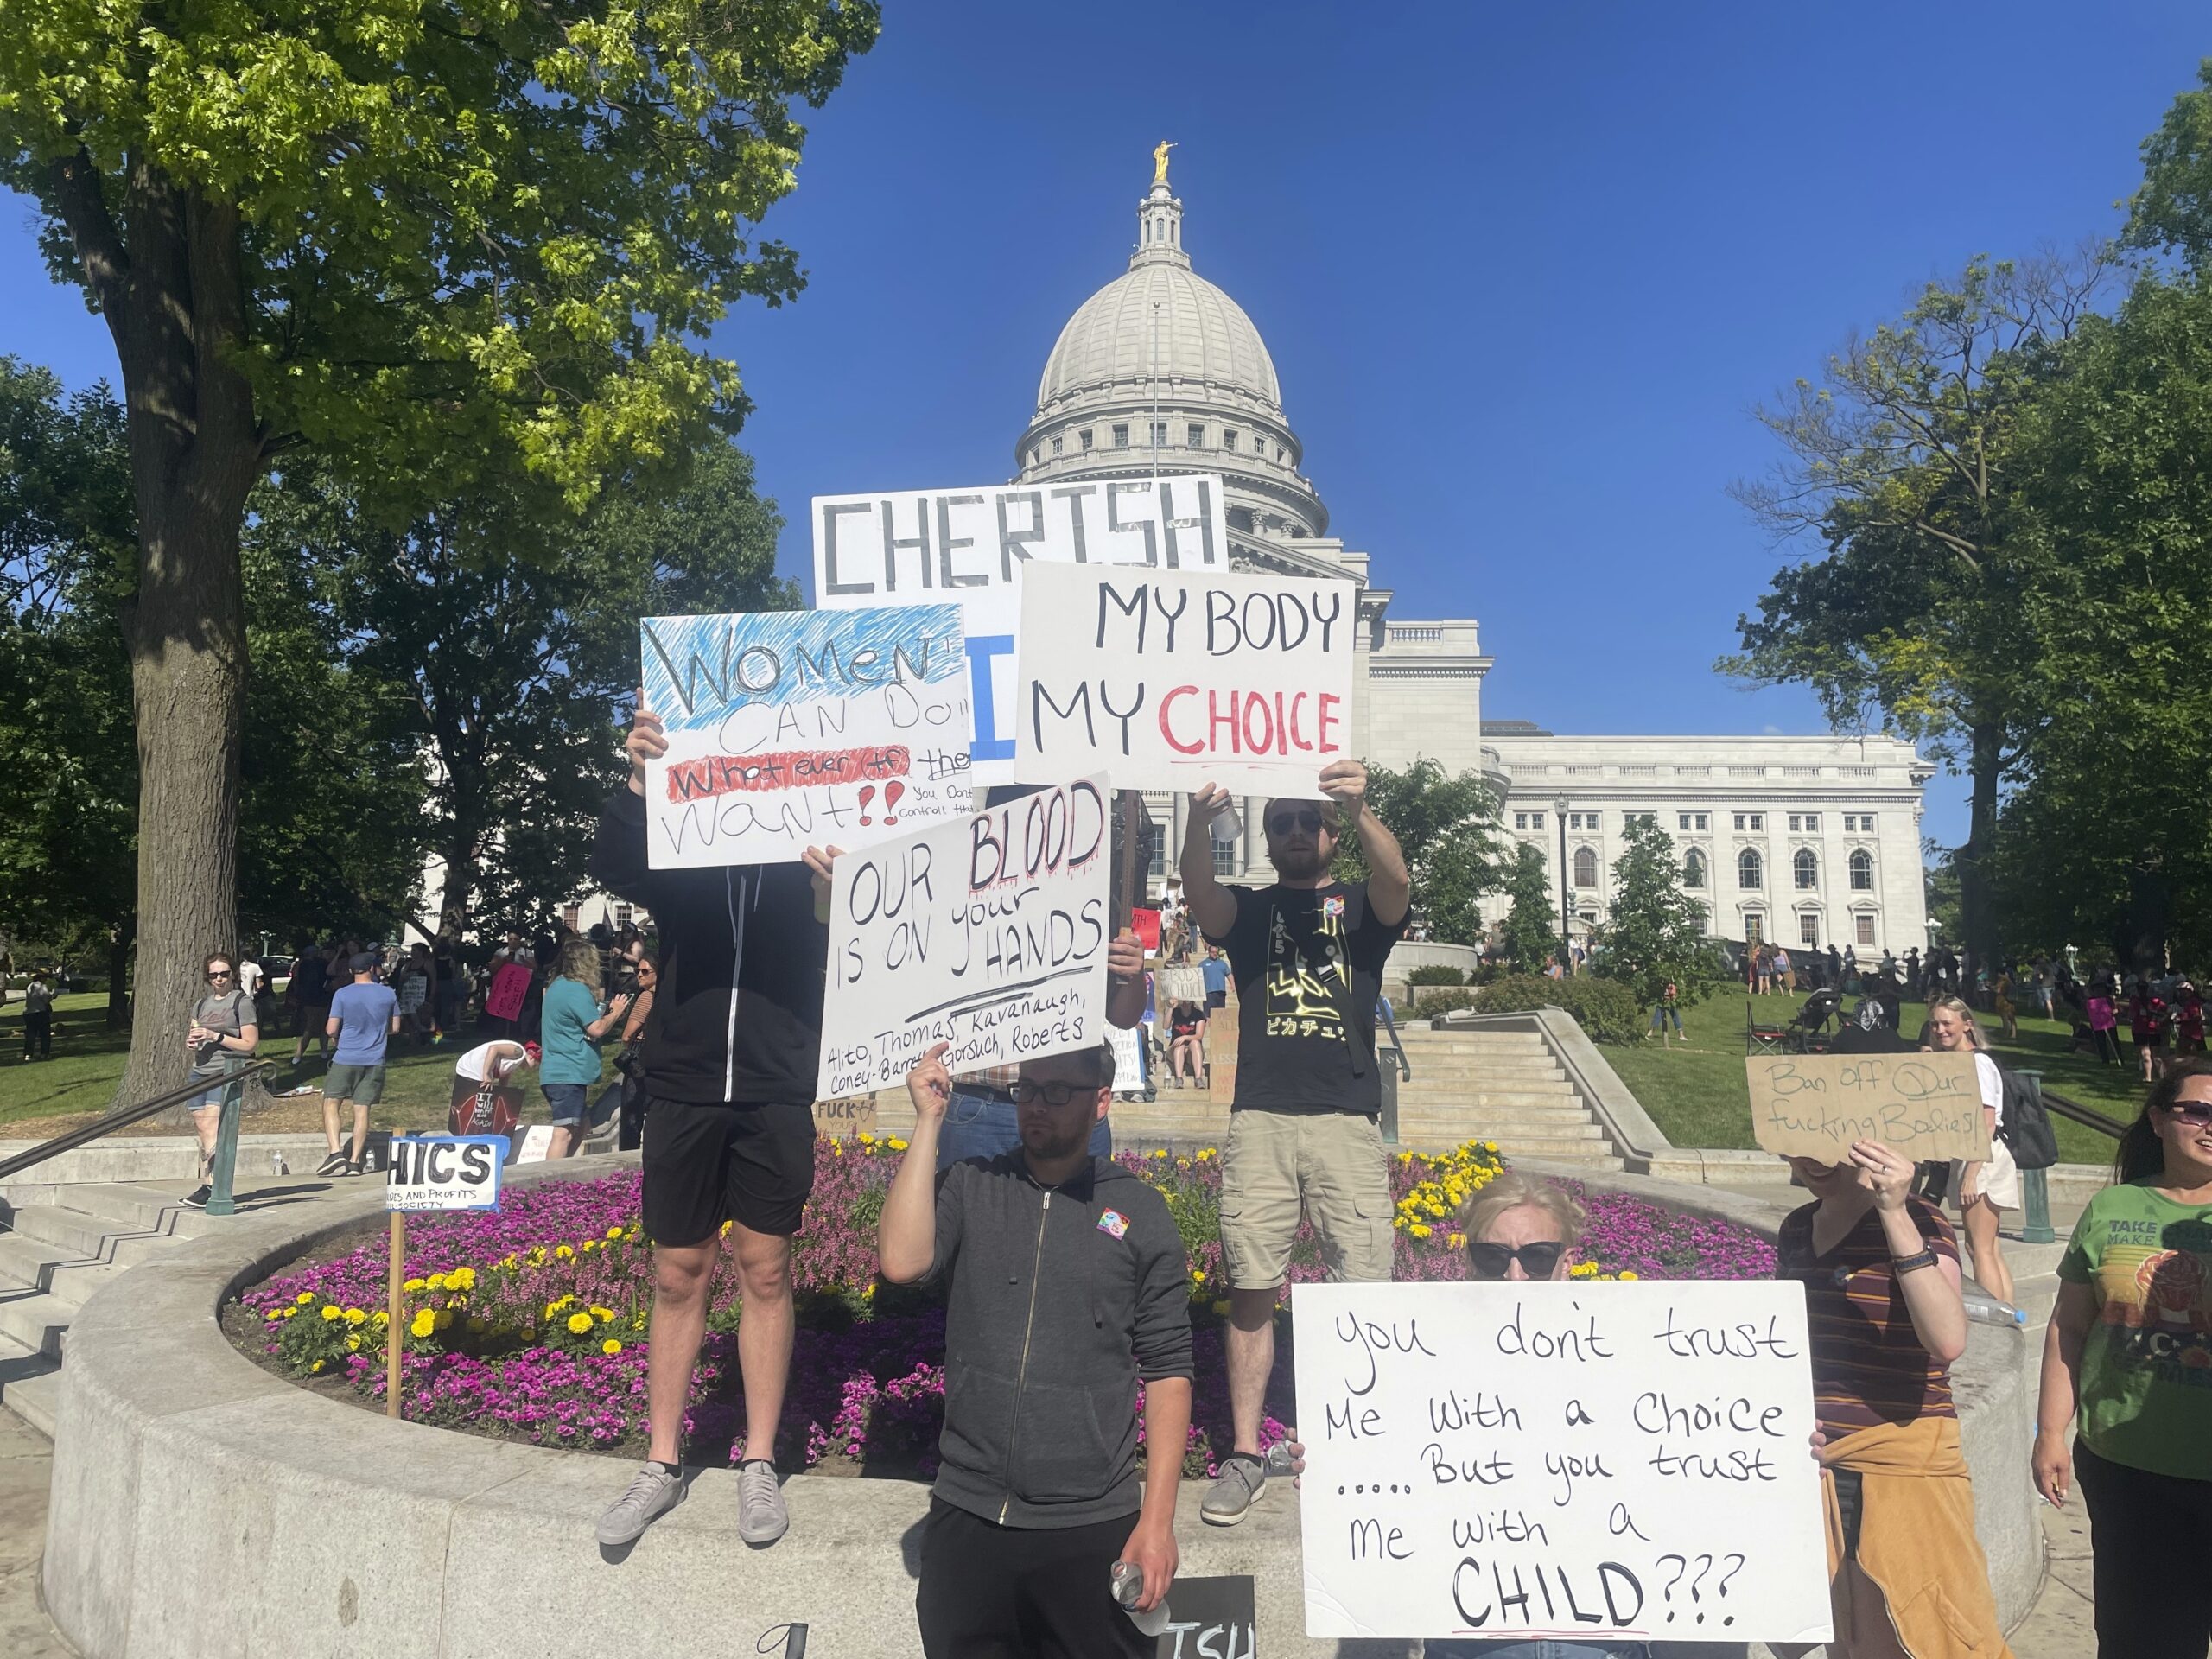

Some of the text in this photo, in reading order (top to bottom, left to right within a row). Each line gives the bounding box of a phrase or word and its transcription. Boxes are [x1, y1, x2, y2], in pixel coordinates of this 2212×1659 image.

[1096, 582, 1340, 656] MY BODY
[719, 700, 846, 754] CAN
[1032, 679, 1341, 757] MY CHOICE
[849, 779, 1104, 925] OUR BLOOD
[837, 938, 864, 990] IS
[887, 915, 931, 971] ON
[987, 899, 1103, 982] HANDS
[828, 1045, 872, 1073] Alito,
[972, 988, 1085, 1032] Kavanaugh,
[1012, 1017, 1084, 1052] Roberts
[1765, 1063, 1827, 1096] Ban
[817, 1102, 856, 1119] FUCK
[406, 1192, 426, 1200] AND
[429, 1189, 477, 1200] PROFITS
[2107, 1234, 2155, 1245] MAKE
[2109, 1219, 2158, 1233] TAKE
[1336, 1301, 1799, 1395] you don't trust
[1326, 1401, 1386, 1440] Me
[1566, 1398, 1595, 1427] a
[1421, 1443, 1514, 1485] But
[1545, 1450, 1614, 1507] you
[1649, 1448, 1777, 1482] trust
[1610, 1503, 1651, 1542] a
